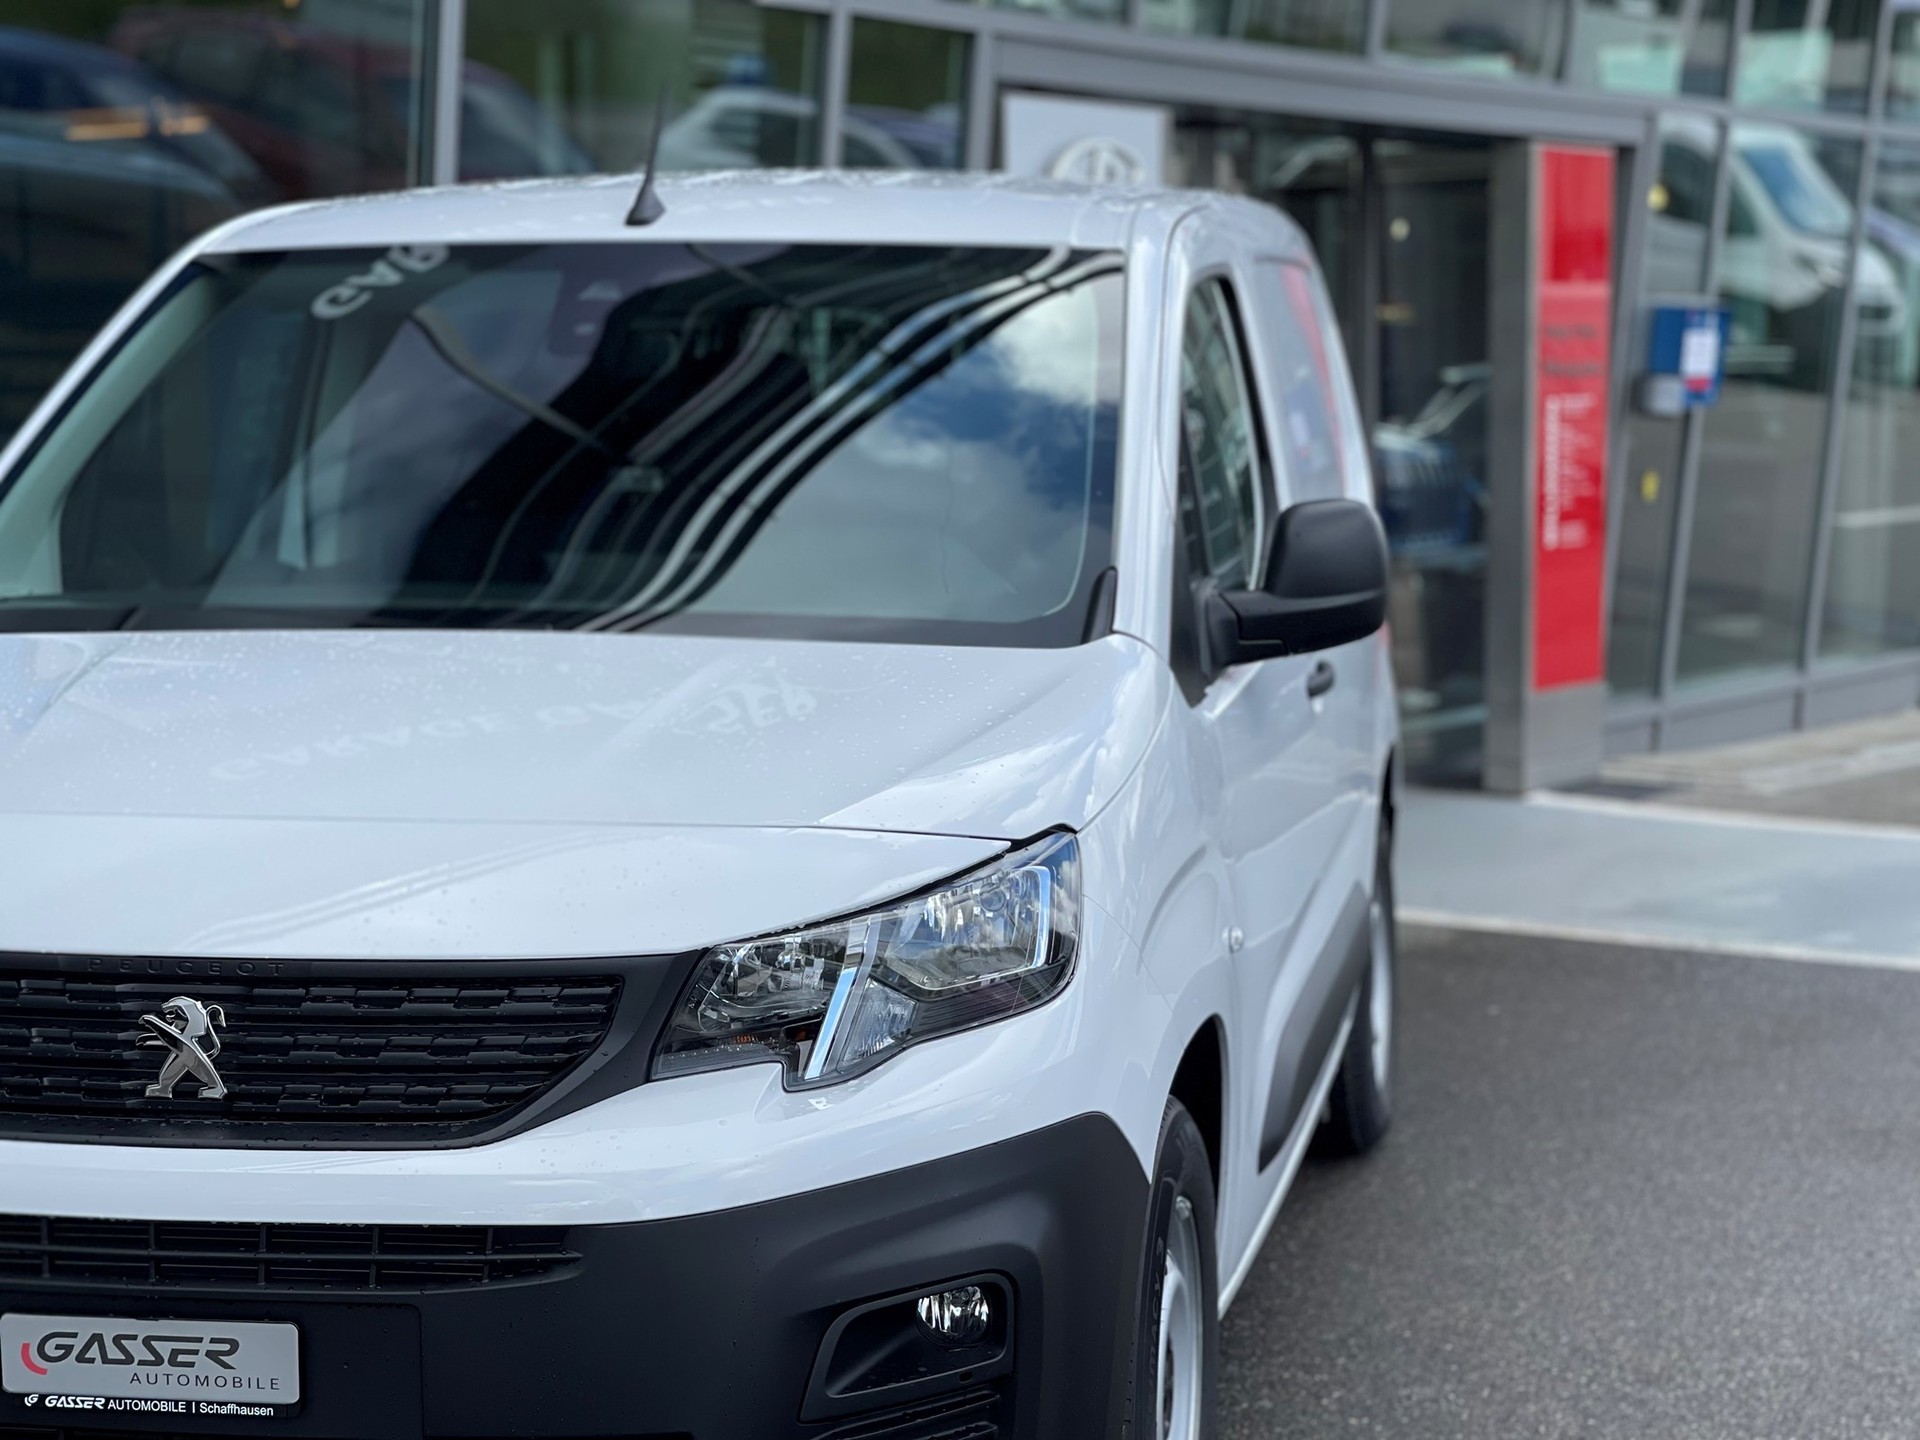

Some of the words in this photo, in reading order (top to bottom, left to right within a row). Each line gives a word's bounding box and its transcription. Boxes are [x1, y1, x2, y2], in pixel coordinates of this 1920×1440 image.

[87, 958, 284, 976] PEUGEOT
[36, 1331, 240, 1370] GASSER
[129, 1372, 280, 1390] AUTOMOBILE
[45, 1395, 105, 1409] GASSER
[107, 1399, 186, 1413] AUTOMOBILE
[199, 1402, 274, 1416] Schaffhausen
